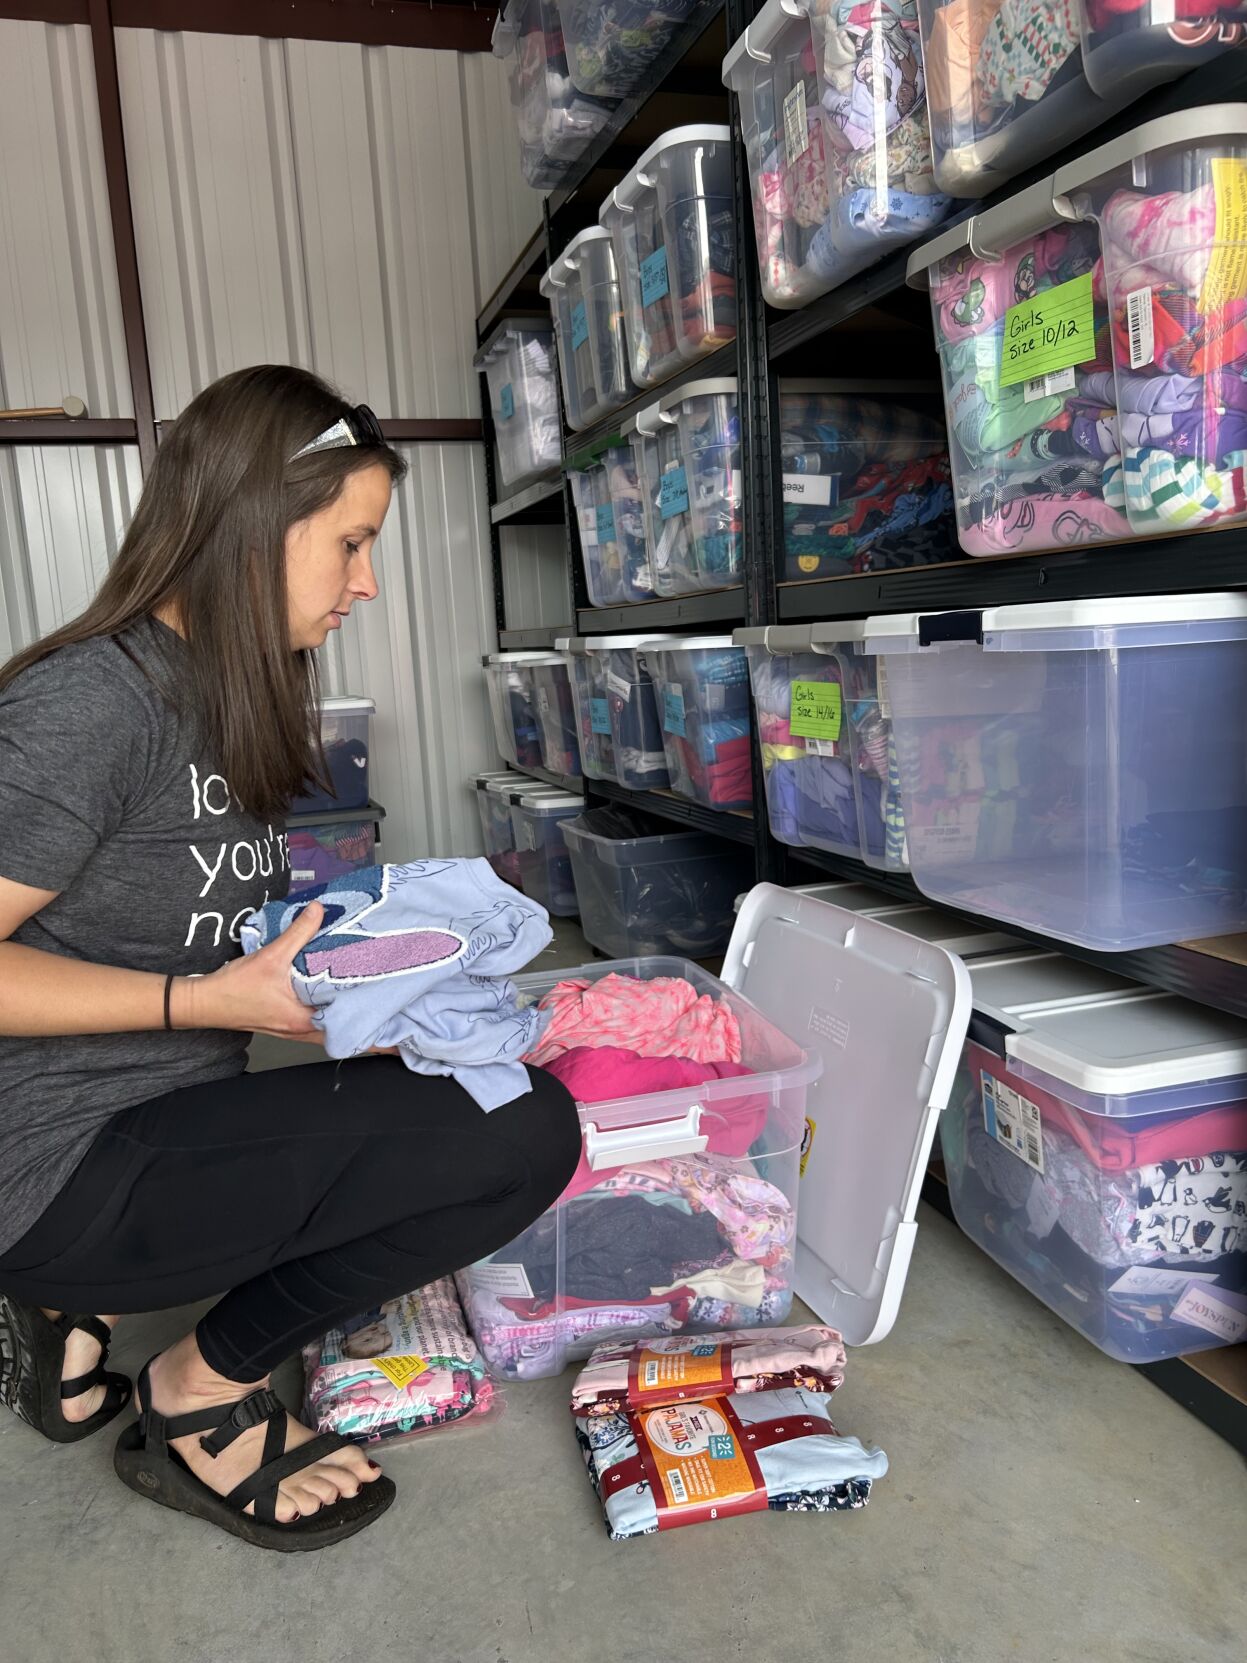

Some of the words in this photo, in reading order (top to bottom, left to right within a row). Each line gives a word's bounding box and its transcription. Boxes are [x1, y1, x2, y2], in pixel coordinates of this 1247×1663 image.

[1010, 310, 1044, 338] Girls
[1042, 320, 1079, 346] 10/12
[796, 685, 814, 701] Girls
[661, 1408, 692, 1452] PAJAMAS
[717, 1442, 732, 1450] 2
[711, 1509, 717, 1518] 8
